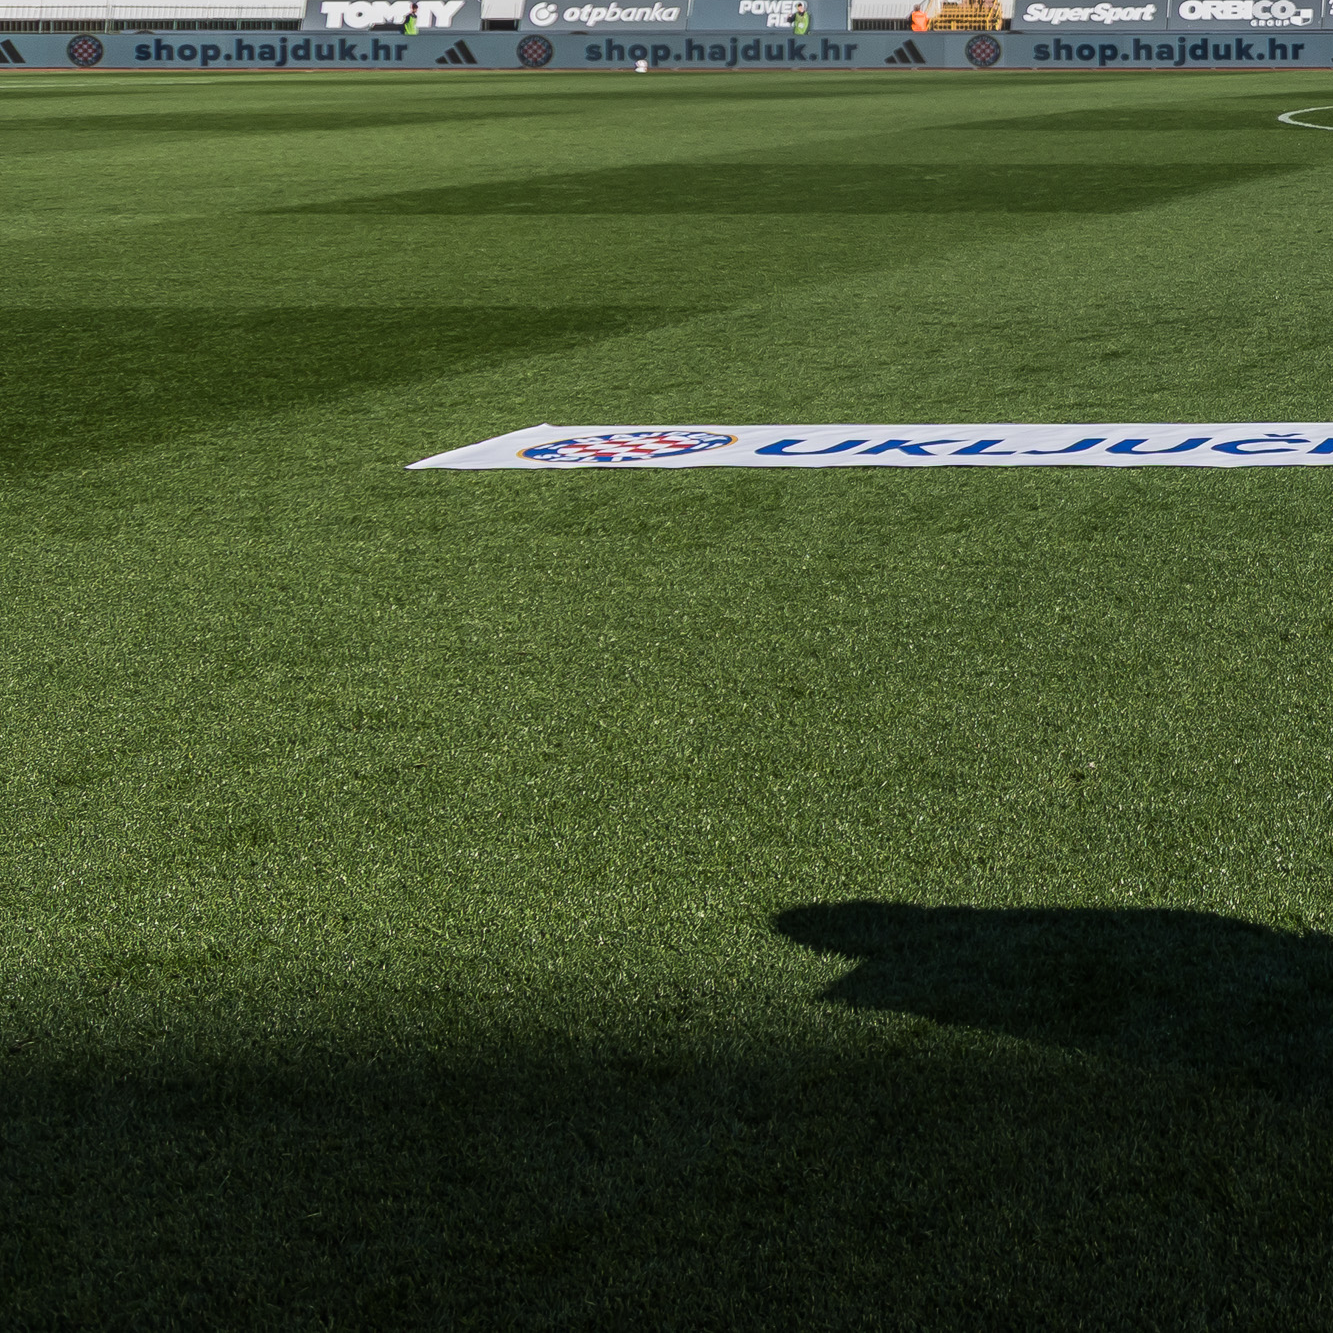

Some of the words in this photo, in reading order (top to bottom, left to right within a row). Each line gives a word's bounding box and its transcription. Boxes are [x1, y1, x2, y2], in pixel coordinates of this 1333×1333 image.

[562, 1, 681, 26] otpbanka
[1023, 2, 1157, 25] SuperSport
[1178, 0, 1296, 20] ORBICO
[1250, 19, 1290, 27] GROUP
[135, 37, 407, 66] shop.hajduk.hr
[585, 37, 857, 67] shop.hajduk.hr
[1033, 37, 1304, 66] shop.hajduk.hr
